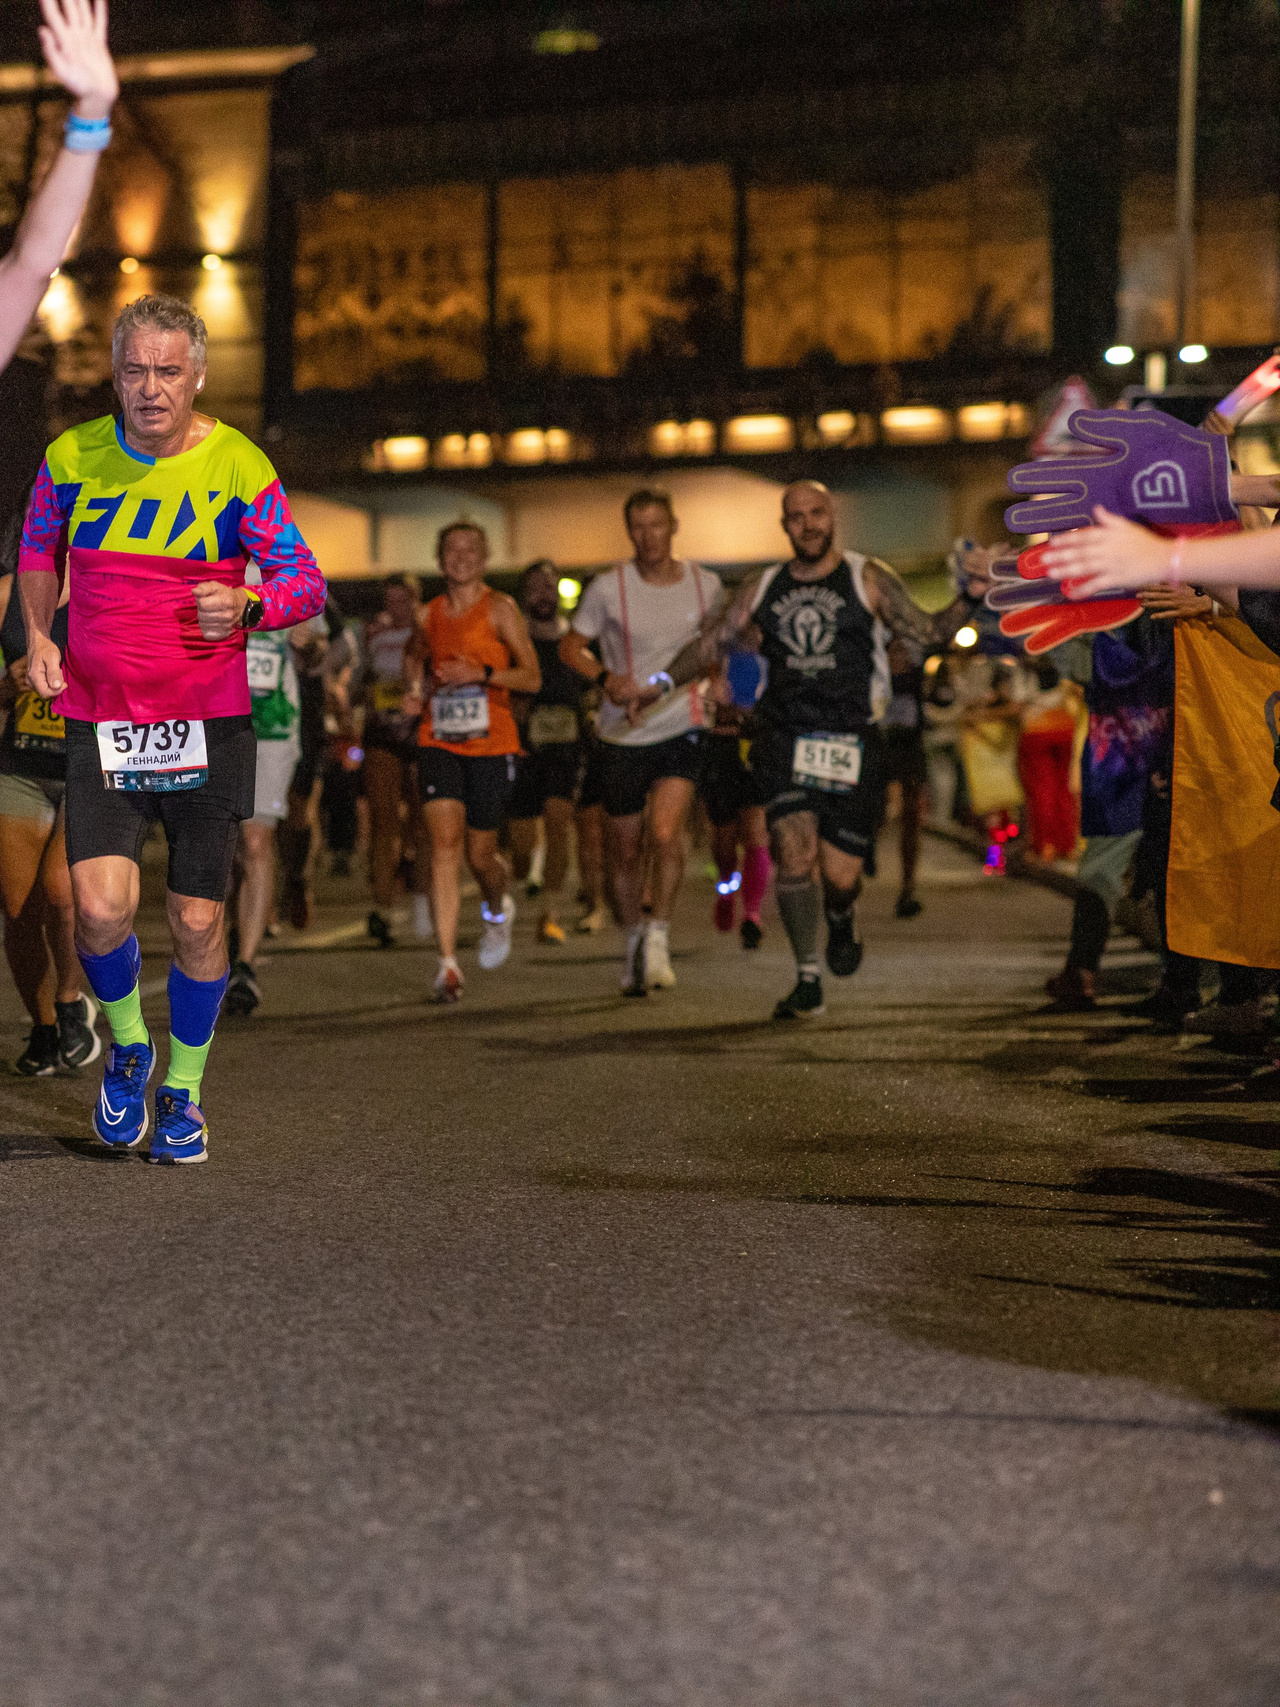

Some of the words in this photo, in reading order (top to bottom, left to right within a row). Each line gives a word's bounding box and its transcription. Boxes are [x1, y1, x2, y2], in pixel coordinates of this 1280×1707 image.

[69, 488, 225, 563] FOX
[112, 720, 190, 753] 5739
[127, 752, 181, 765] ГЕННАДИЙ
[113, 773, 126, 789] E
